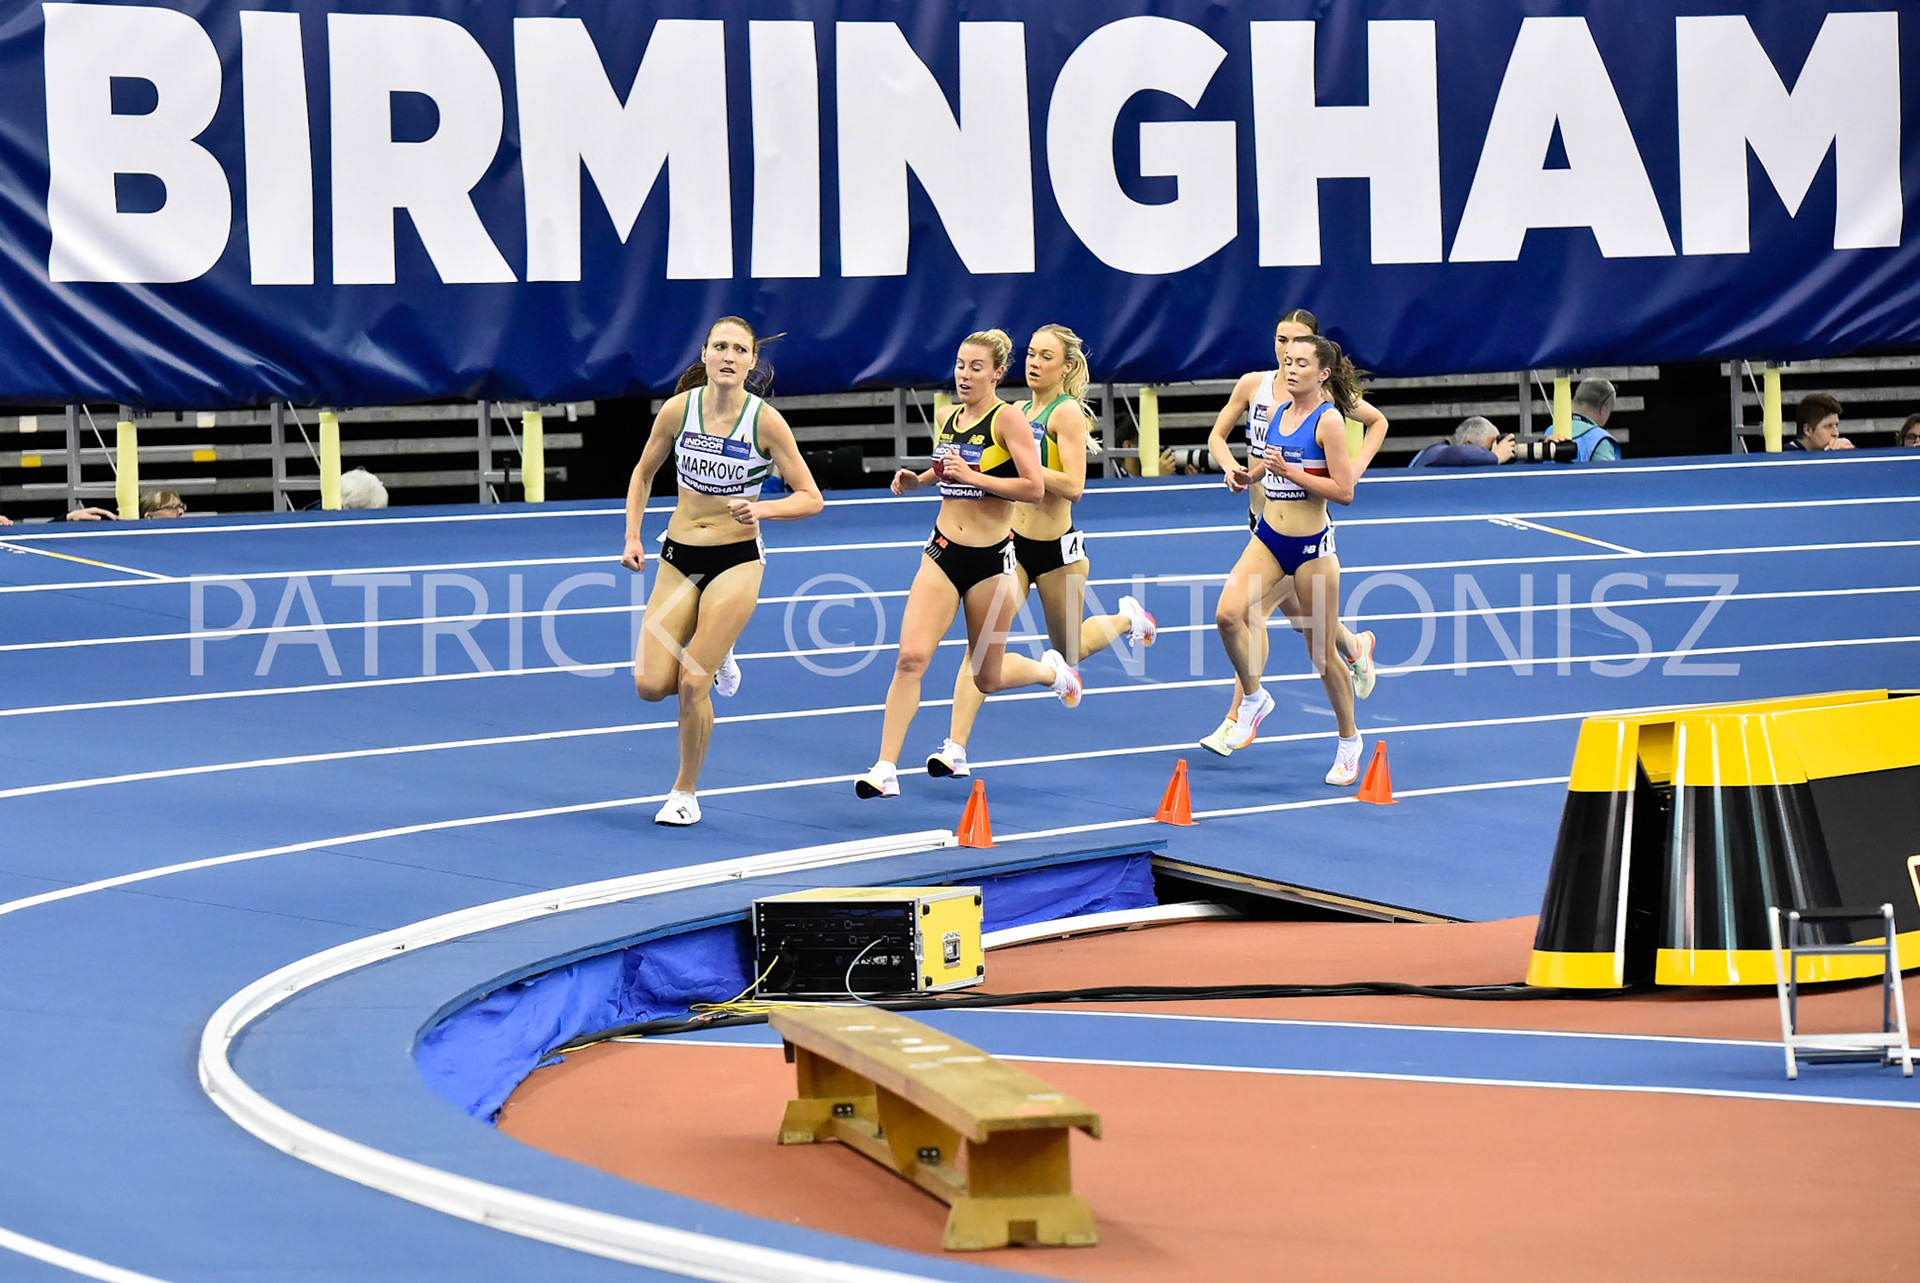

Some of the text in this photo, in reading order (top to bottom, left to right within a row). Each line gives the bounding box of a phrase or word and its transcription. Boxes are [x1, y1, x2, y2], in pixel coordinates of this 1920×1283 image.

[42, 2, 1904, 286] BIRMINGHAM
[1254, 425, 1267, 442] W
[685, 437, 724, 451] INDOOR
[681, 454, 744, 480] MARKOVC
[684, 476, 742, 493] BIRMINGHAM
[940, 487, 982, 497] INGHAM
[1265, 490, 1305, 499] MINGHAM
[1069, 536, 1078, 556] 4
[1302, 545, 1316, 554] NB
